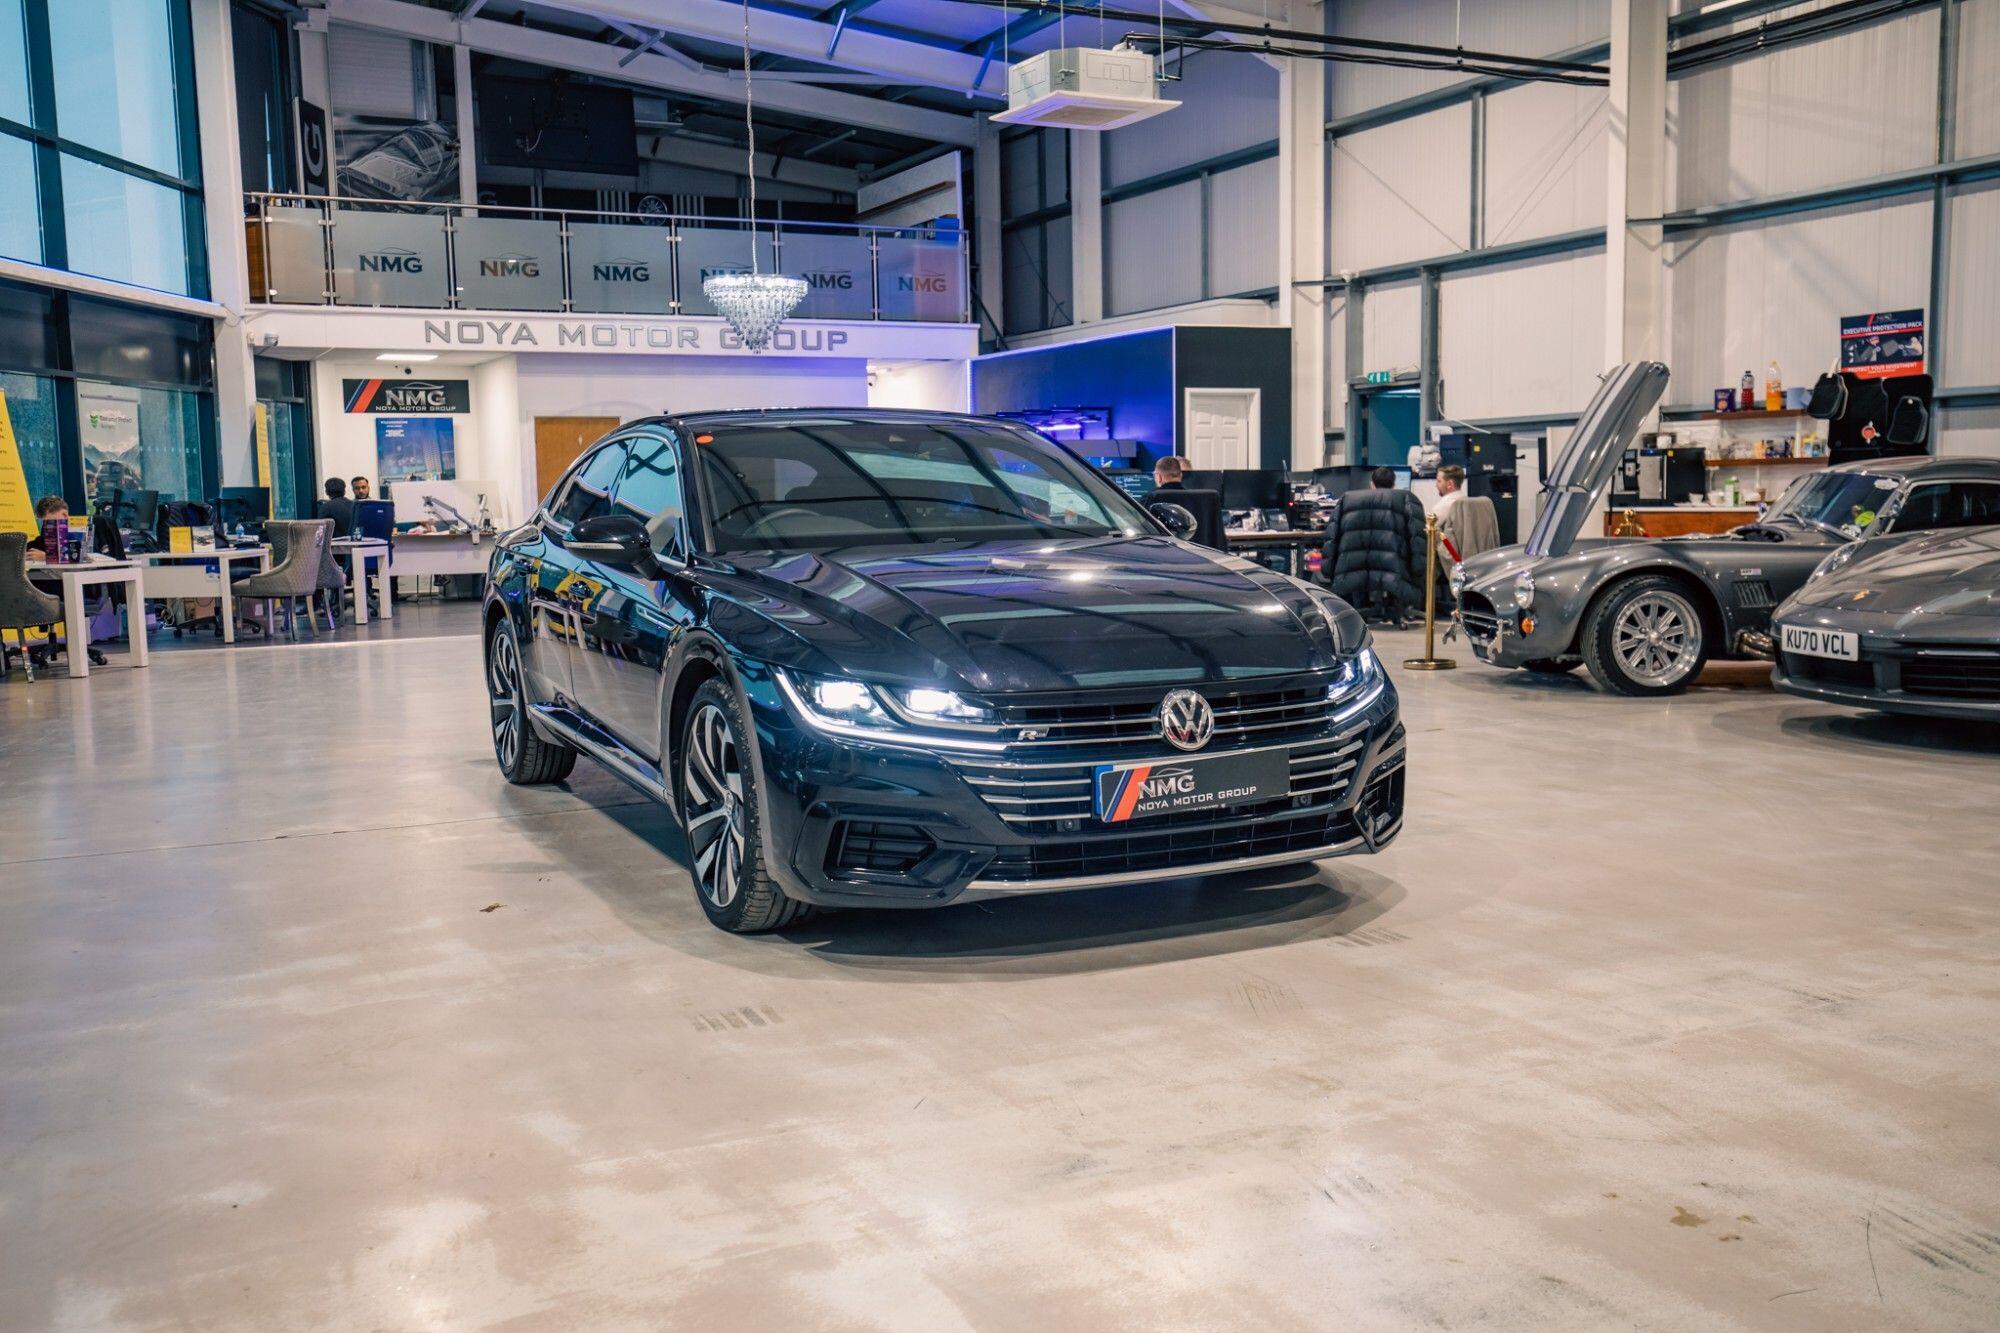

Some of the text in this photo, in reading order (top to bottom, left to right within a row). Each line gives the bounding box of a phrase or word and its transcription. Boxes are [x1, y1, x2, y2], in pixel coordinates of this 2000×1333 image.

[359, 255, 423, 273] NMG
[480, 260, 540, 278] NMG
[593, 265, 650, 282] NMG
[898, 276, 947, 293] NMG
[424, 320, 848, 351] NOYA MOTOR GOUP
[1872, 323, 1907, 332] PROTECTION
[385, 390, 446, 406] NMG
[1787, 629, 1850, 656] KU70 VCL
[1138, 774, 1195, 800] NMG
[1138, 786, 1257, 812] NOYA MOTOR GROUP
